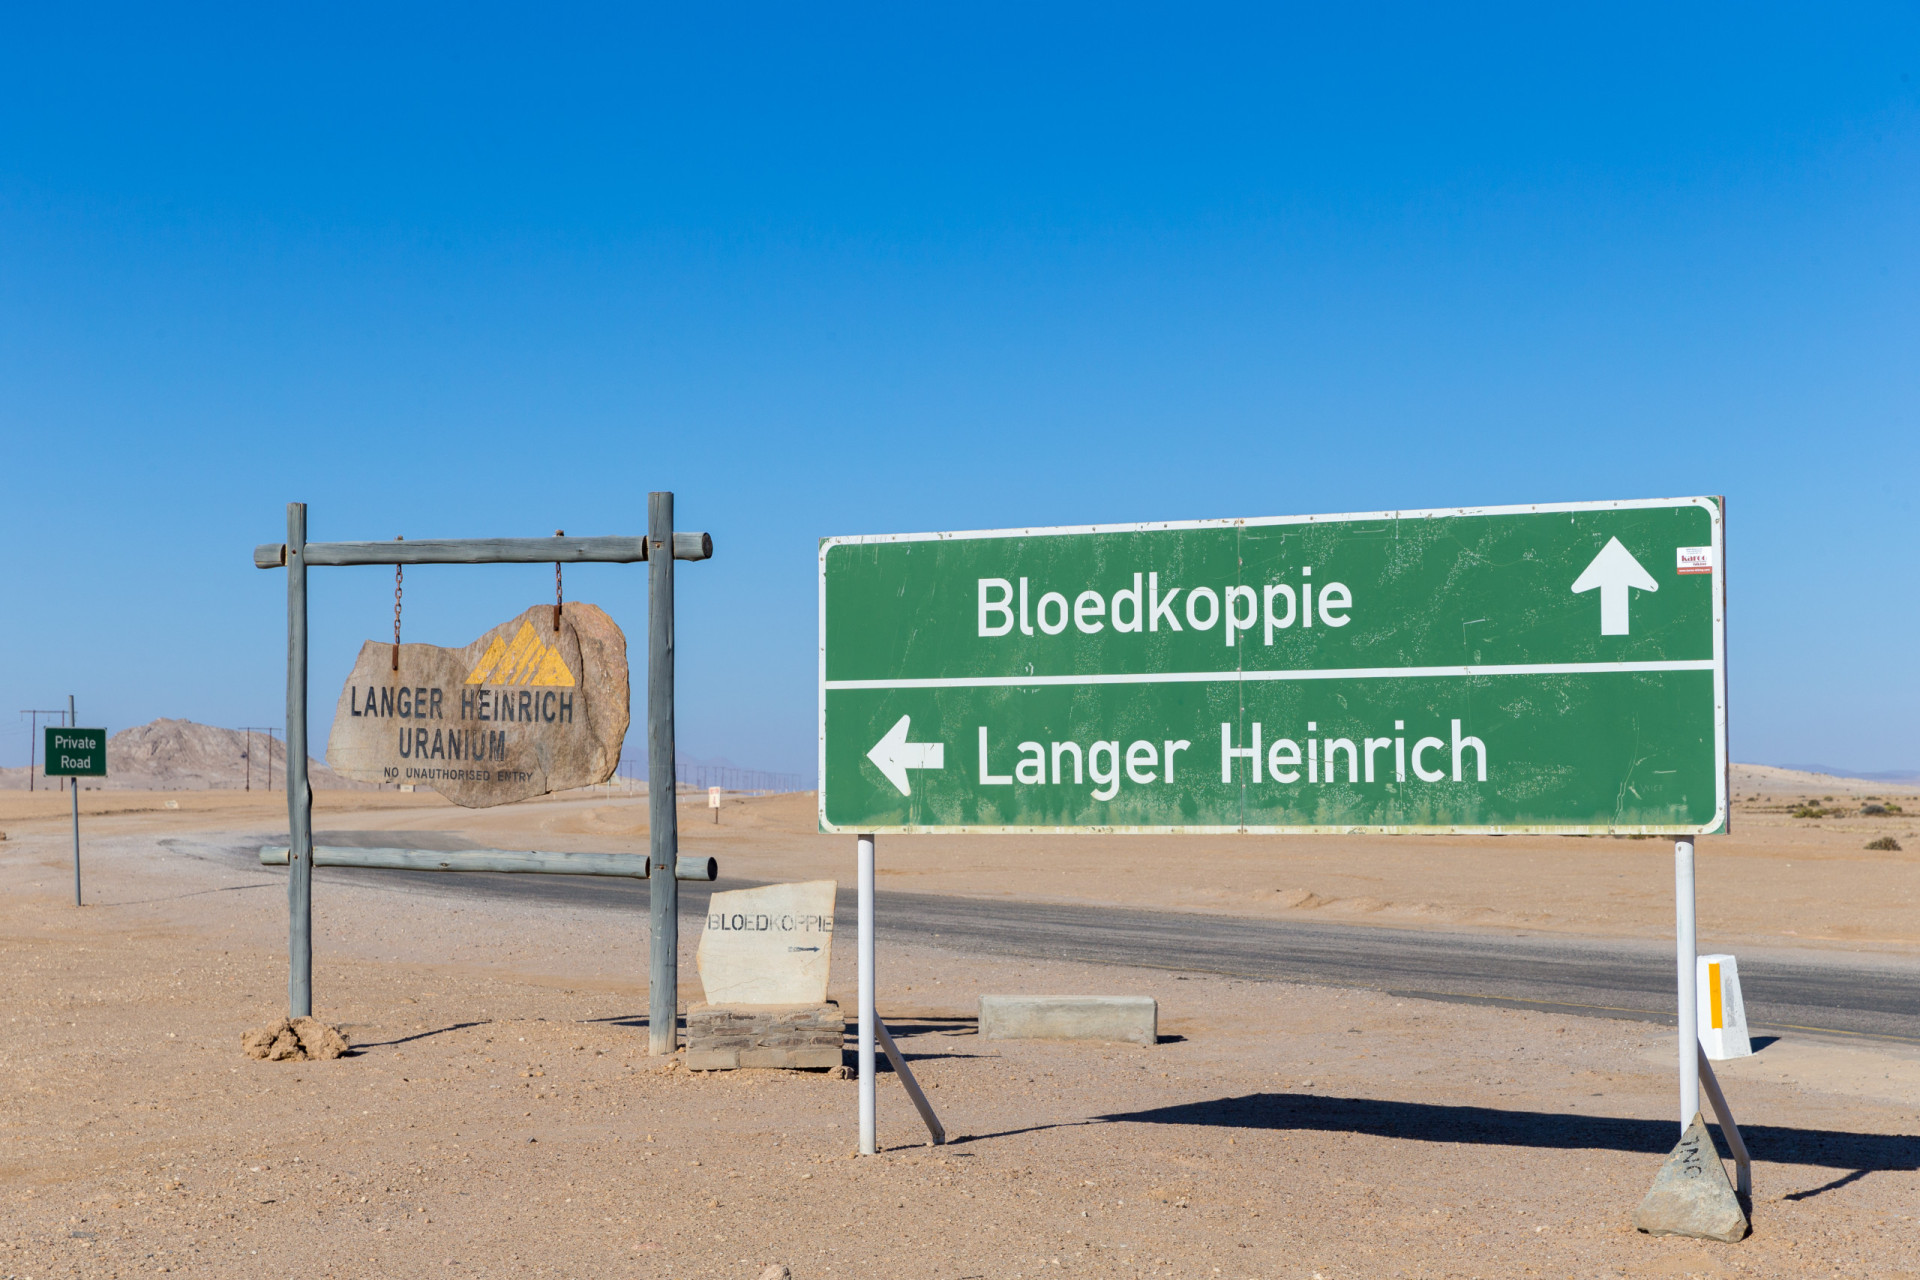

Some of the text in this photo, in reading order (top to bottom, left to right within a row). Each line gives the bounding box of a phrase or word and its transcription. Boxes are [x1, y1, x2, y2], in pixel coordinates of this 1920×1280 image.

[976, 565, 1353, 647] Bloedkoppie
[350, 685, 574, 724] LANGER HEINRICH
[55, 735, 96, 749] Private
[399, 727, 506, 762] URANIUM
[61, 755, 91, 769] Road
[978, 718, 1488, 802] Langer Heinrich
[384, 766, 534, 782] NO UNAUTHORISED ENTRY
[708, 913, 834, 932] BLOEDKOPPIE
